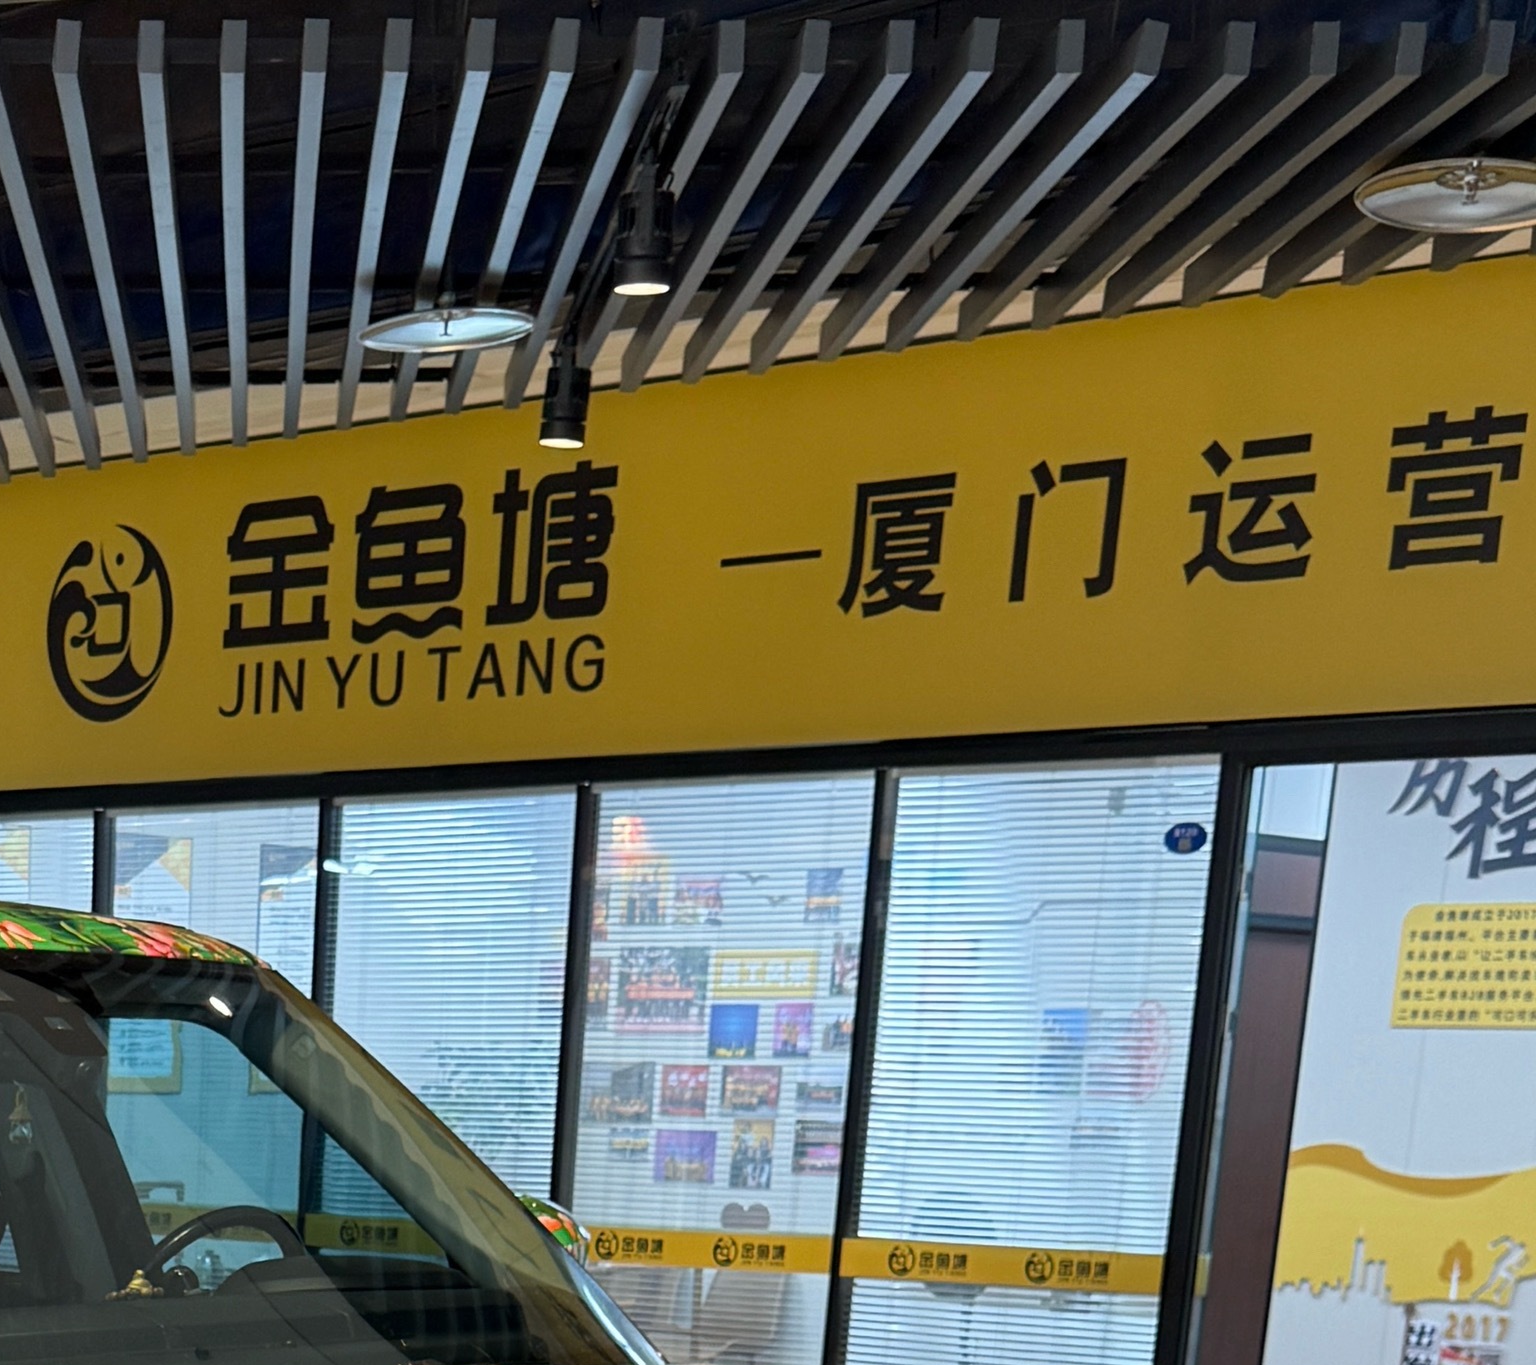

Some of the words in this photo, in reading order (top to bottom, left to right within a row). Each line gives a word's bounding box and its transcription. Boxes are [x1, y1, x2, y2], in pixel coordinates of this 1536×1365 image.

[222, 460, 619, 650] 金鱼塘
[426, 633, 607, 703] TANG
[1444, 1311, 1509, 1342] 2017
